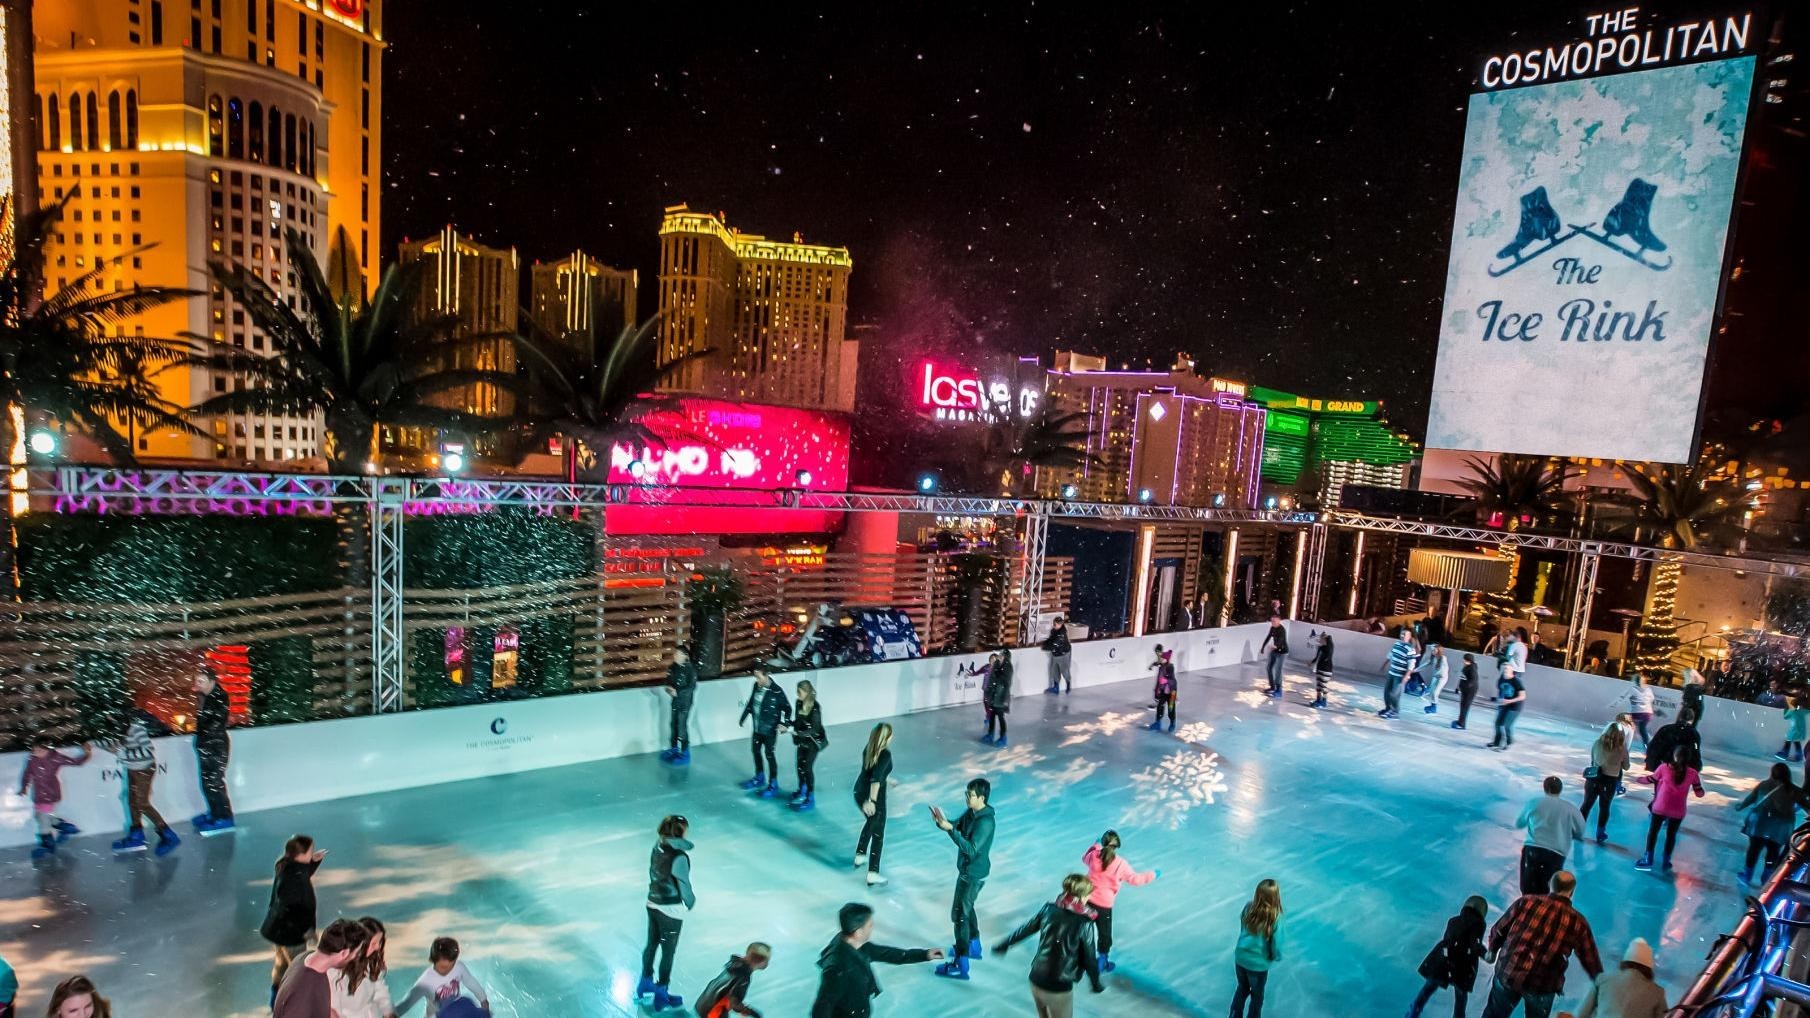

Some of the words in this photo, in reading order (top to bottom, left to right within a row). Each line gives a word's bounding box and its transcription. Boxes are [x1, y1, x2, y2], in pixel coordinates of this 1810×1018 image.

[1586, 7, 1639, 36] THE
[1482, 14, 1750, 88] COSMOPOLITAN
[1552, 257, 1602, 285] The
[1477, 300, 1543, 342] Ice
[1557, 298, 1669, 342] Rink
[1327, 401, 1364, 412] GRAND
[490, 717, 505, 735] C
[102, 760, 168, 781] PAN
